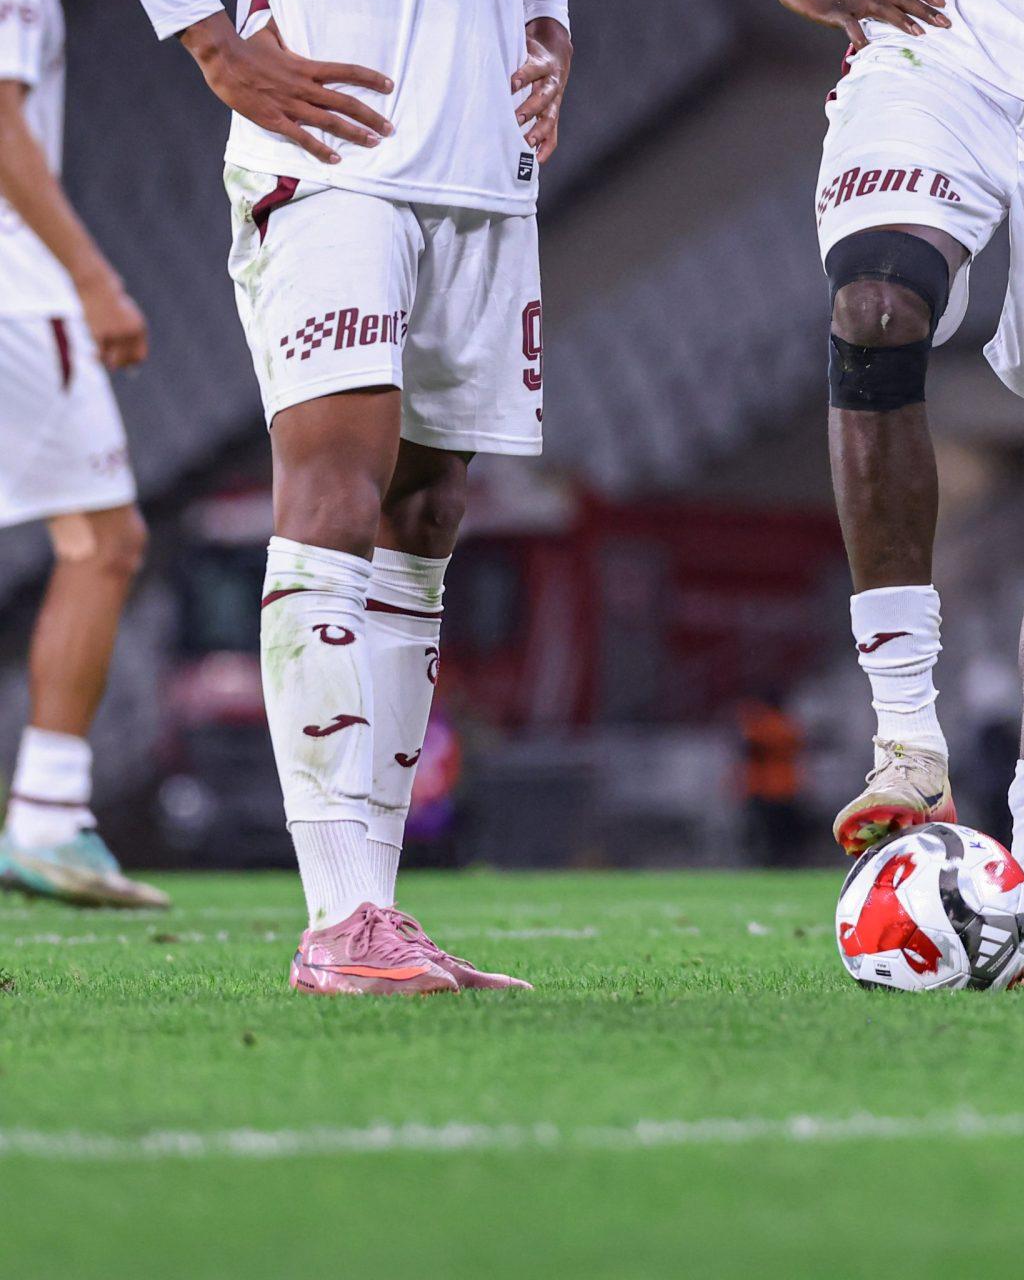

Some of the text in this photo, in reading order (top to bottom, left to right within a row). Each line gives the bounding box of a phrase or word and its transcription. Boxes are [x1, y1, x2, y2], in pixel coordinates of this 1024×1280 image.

[833, 166, 924, 208] Rent
[333, 307, 398, 350] Rent
[522, 299, 543, 391] 9
